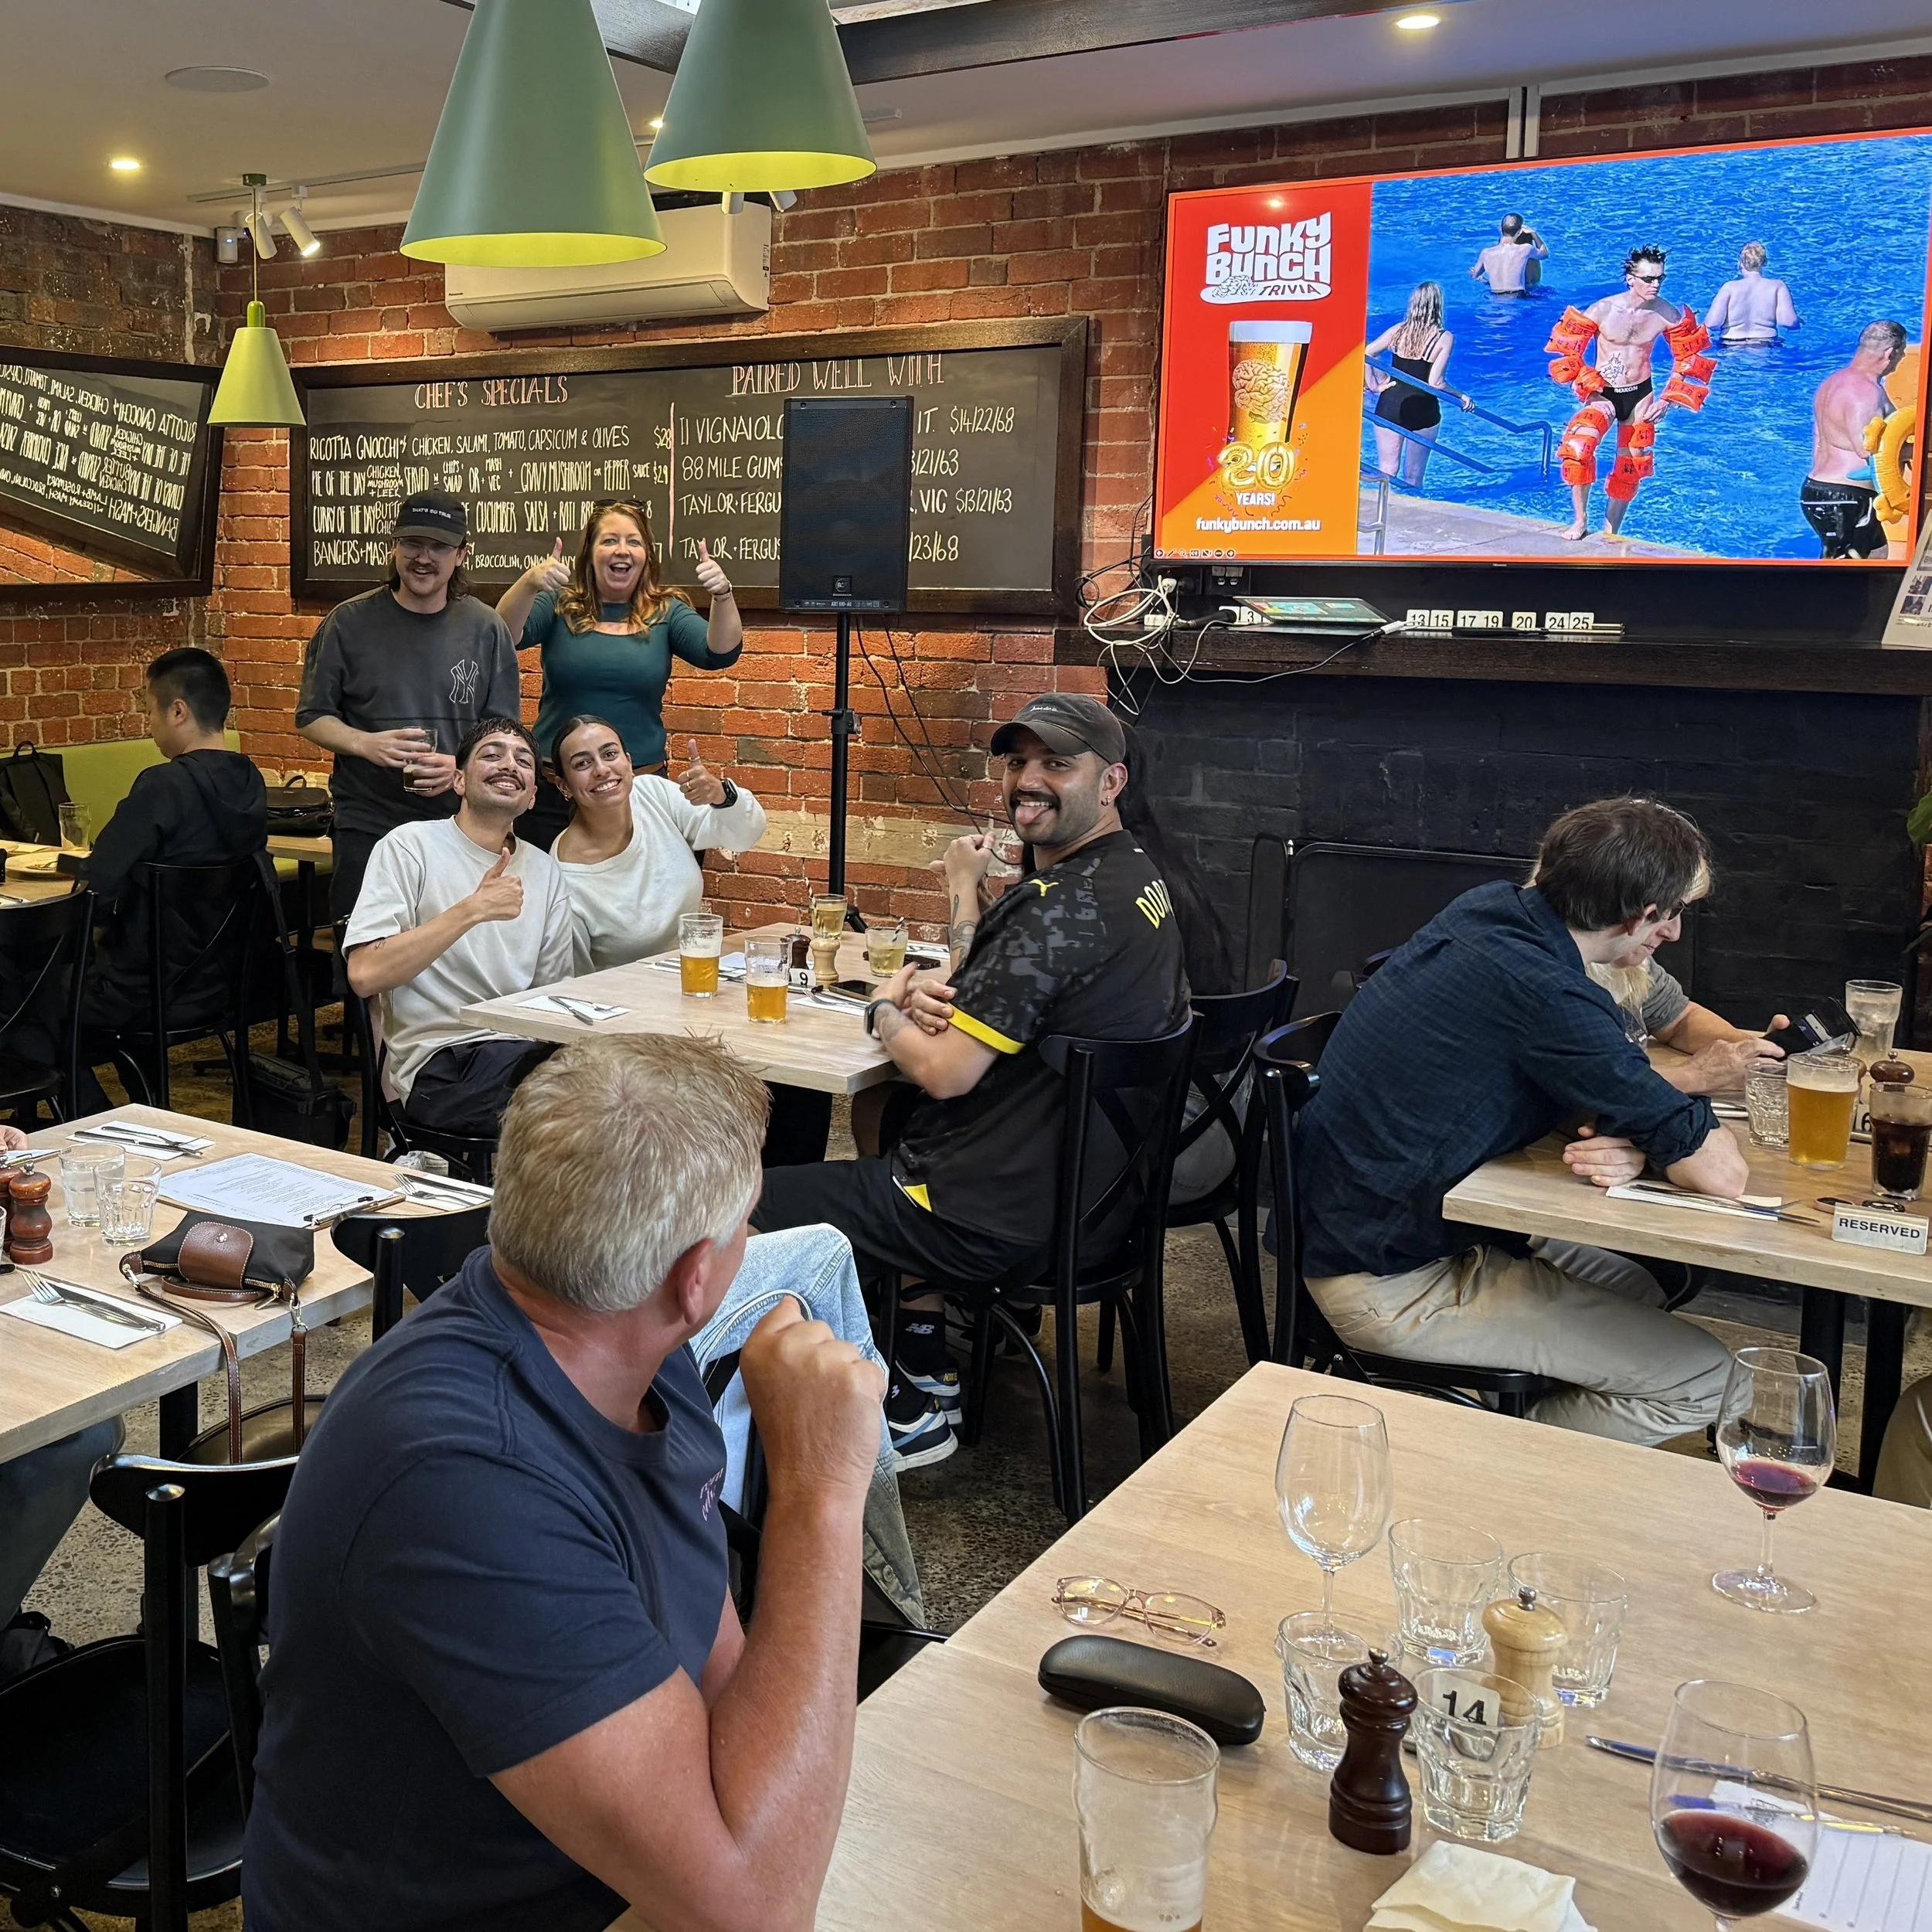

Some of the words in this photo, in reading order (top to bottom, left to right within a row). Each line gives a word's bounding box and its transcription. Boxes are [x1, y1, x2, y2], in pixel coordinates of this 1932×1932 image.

[1258, 284, 1322, 295] TRIVIA
[732, 362, 801, 395] PAIRED
[812, 359, 872, 390] WELL
[888, 353, 944, 387] WITH
[414, 382, 468, 410] CHEF'S
[481, 376, 567, 406] SPECIALS
[917, 407, 938, 434] IT.
[951, 406, 1015, 434] $14/22/68
[310, 435, 352, 461] RICOTTA
[356, 434, 399, 461] GNOCCHI
[412, 435, 454, 457] CHICKEN,
[456, 434, 491, 454] SALAMI,
[493, 430, 526, 451] TOMATO,
[529, 428, 578, 451] CAPSICUM
[581, 430, 588, 445] &
[593, 425, 630, 448] OLIVES
[654, 425, 672, 450] $28
[682, 455, 704, 481] 88
[707, 456, 742, 478] MILE
[747, 455, 783, 479] GUM
[1216, 441, 1296, 490] 20
[325, 471, 335, 496] OF
[339, 471, 351, 496] THE
[469, 468, 480, 493] OR
[604, 458, 630, 491] PEPPER
[632, 462, 650, 478] SAUCE
[653, 461, 668, 485] $29
[367, 479, 403, 488] MUSHROOM
[377, 488, 401, 498] LEEK
[920, 488, 948, 513] VIC
[955, 487, 1012, 515] $13/21/63
[1235, 492, 1276, 505] YEARS!
[337, 506, 345, 533] OF
[350, 505, 361, 534] THE
[476, 501, 516, 533] CUCUMBER
[525, 501, 549, 532] SALSA
[1196, 517, 1321, 534] funkybunch.com.au
[475, 554, 522, 570] BROCCOLINI,
[1434, 614, 1450, 627] 15
[1461, 615, 1477, 628] 17
[1483, 615, 1499, 628] 19
[1516, 616, 1532, 628] 20
[1549, 617, 1565, 629] 24
[1573, 617, 1590, 630] 25
[799, 971, 808, 985] 9
[1838, 1217, 1921, 1240] RESERVED
[943, 1372, 958, 1382] NIKE
[1443, 1690, 1487, 1725] 14
